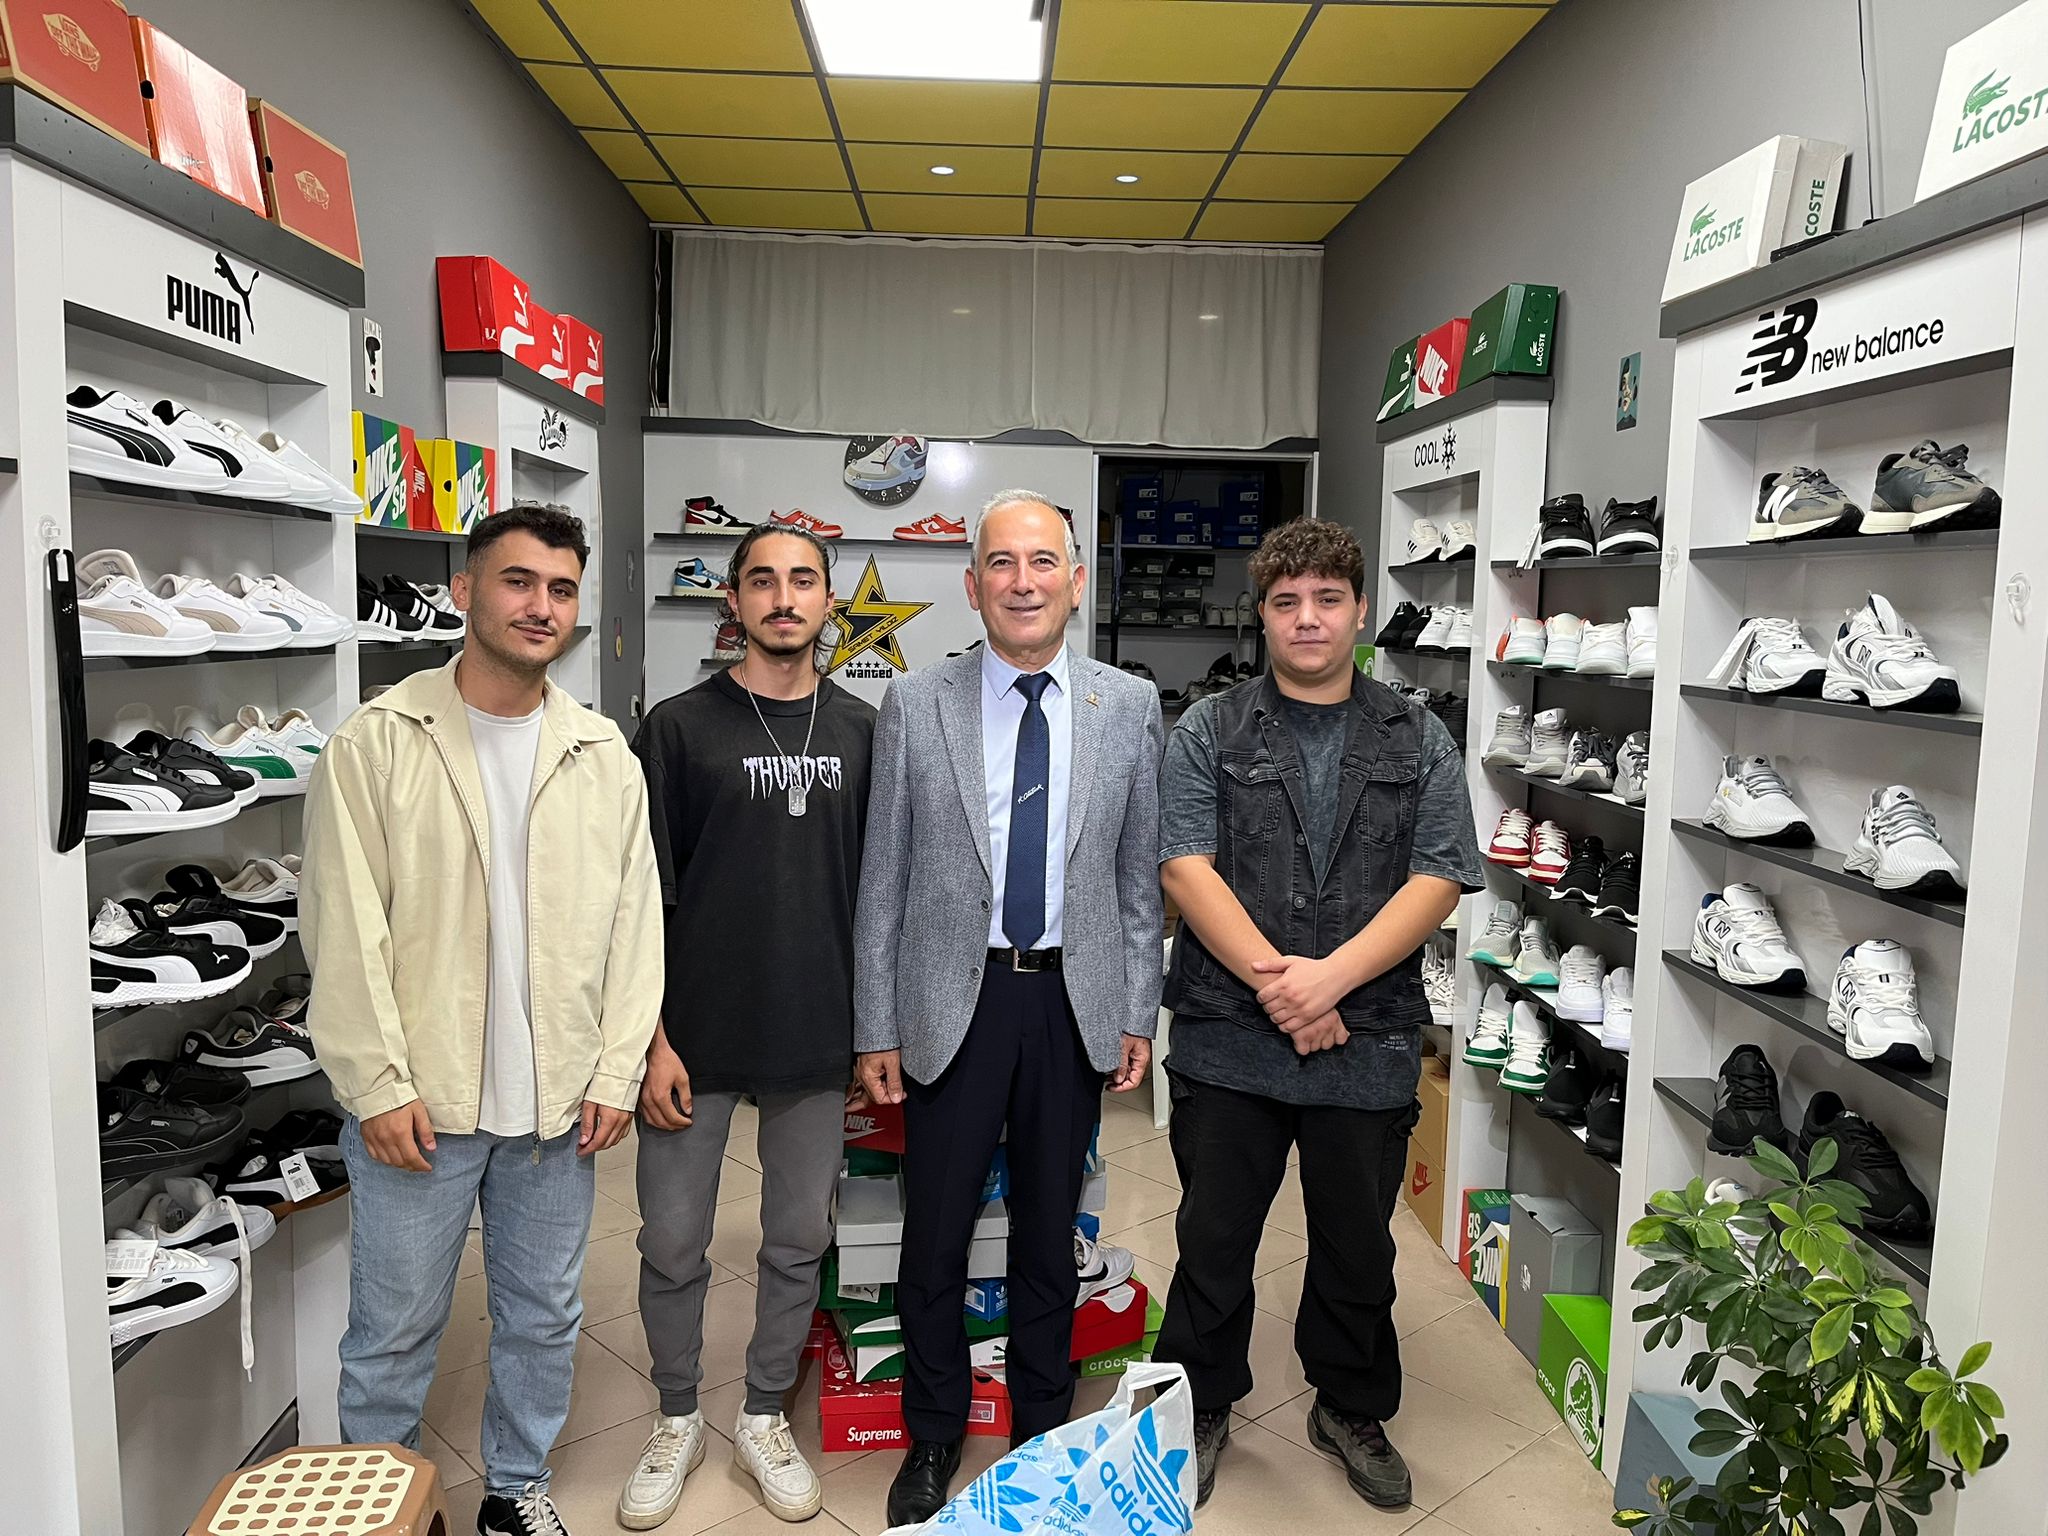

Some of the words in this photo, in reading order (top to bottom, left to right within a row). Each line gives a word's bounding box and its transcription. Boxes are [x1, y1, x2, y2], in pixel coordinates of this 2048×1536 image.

[1953, 88, 2048, 153] LACOST
[1805, 180, 1825, 236] COSTE
[1683, 217, 1744, 261] LACOSTE
[167, 274, 241, 344] PUMA
[1536, 333, 1546, 367] LACOSTE
[1812, 344, 1850, 374] new
[1854, 319, 1944, 363] balance
[1420, 344, 1448, 393] NIKE
[366, 434, 397, 500] NIKE
[1415, 441, 1439, 467] COOL
[392, 479, 406, 520] SB
[457, 459, 482, 522] NIKE
[848, 633, 874, 653] SAMET
[743, 756, 842, 800] THUNDER
[845, 1115, 876, 1131] NIKE
[1467, 1213, 1480, 1239] SB
[1089, 1357, 1129, 1371] crocs
[1538, 1369, 1556, 1397] crocs
[847, 1427, 902, 1445] Supreme
